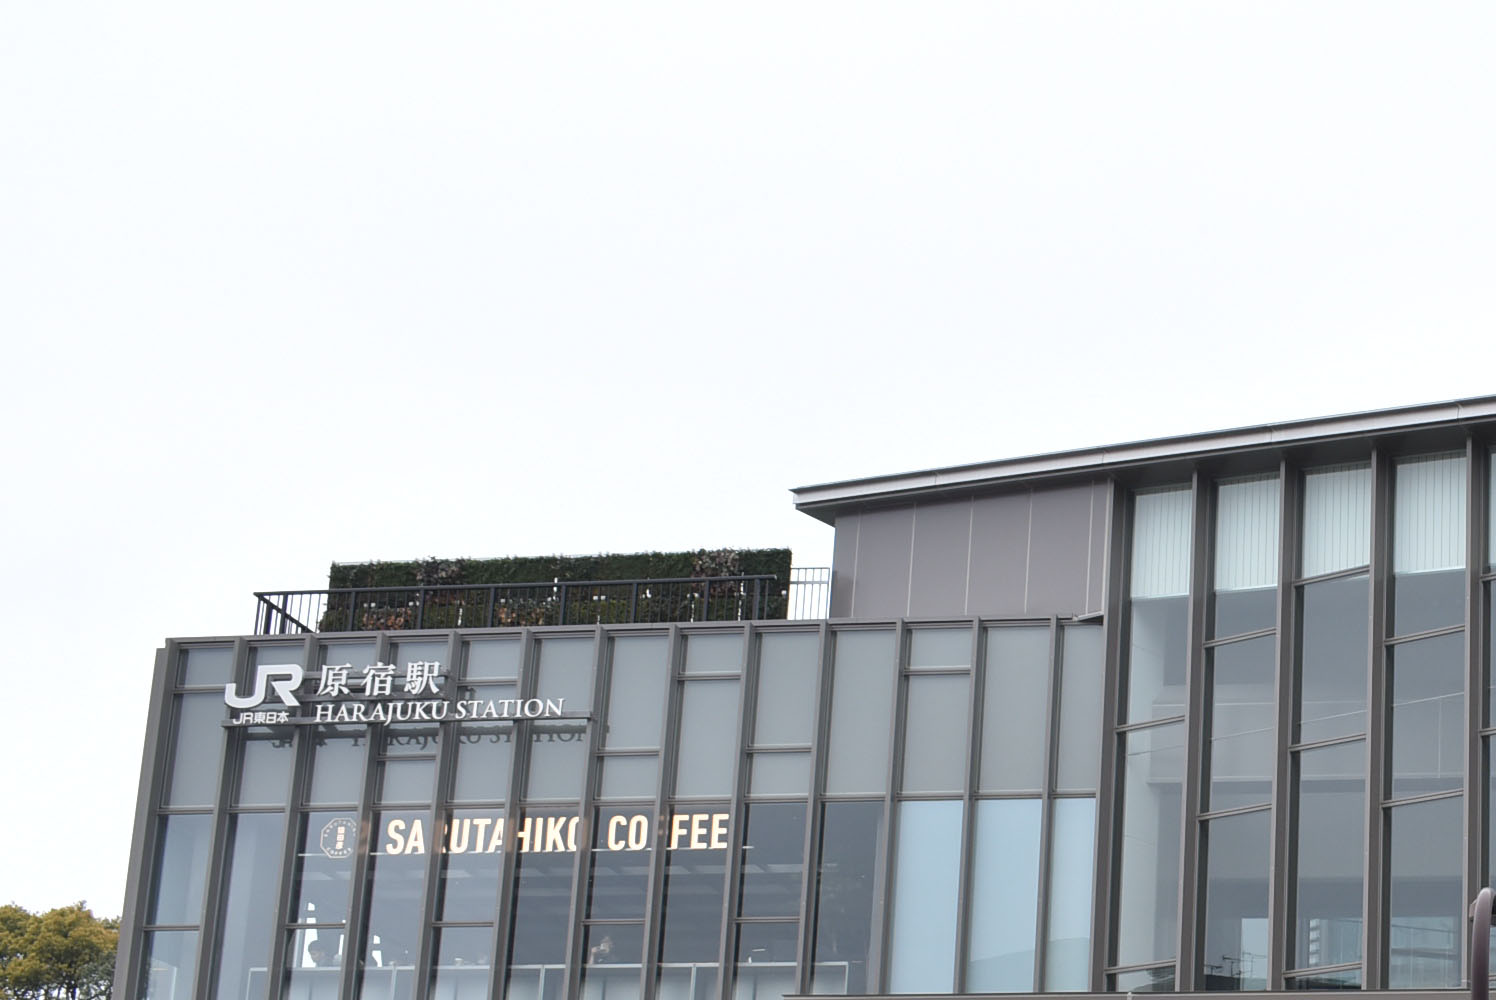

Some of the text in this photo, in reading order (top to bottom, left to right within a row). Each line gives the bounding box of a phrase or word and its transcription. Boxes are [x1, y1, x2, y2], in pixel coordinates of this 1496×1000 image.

[225, 664, 303, 708] JR
[316, 660, 441, 697] 原宿駅
[233, 711, 289, 725] JR東日本
[315, 697, 565, 726] HARAJUKU STATION
[385, 816, 580, 855] SAUTAHIKO
[607, 813, 730, 852] COFEE
